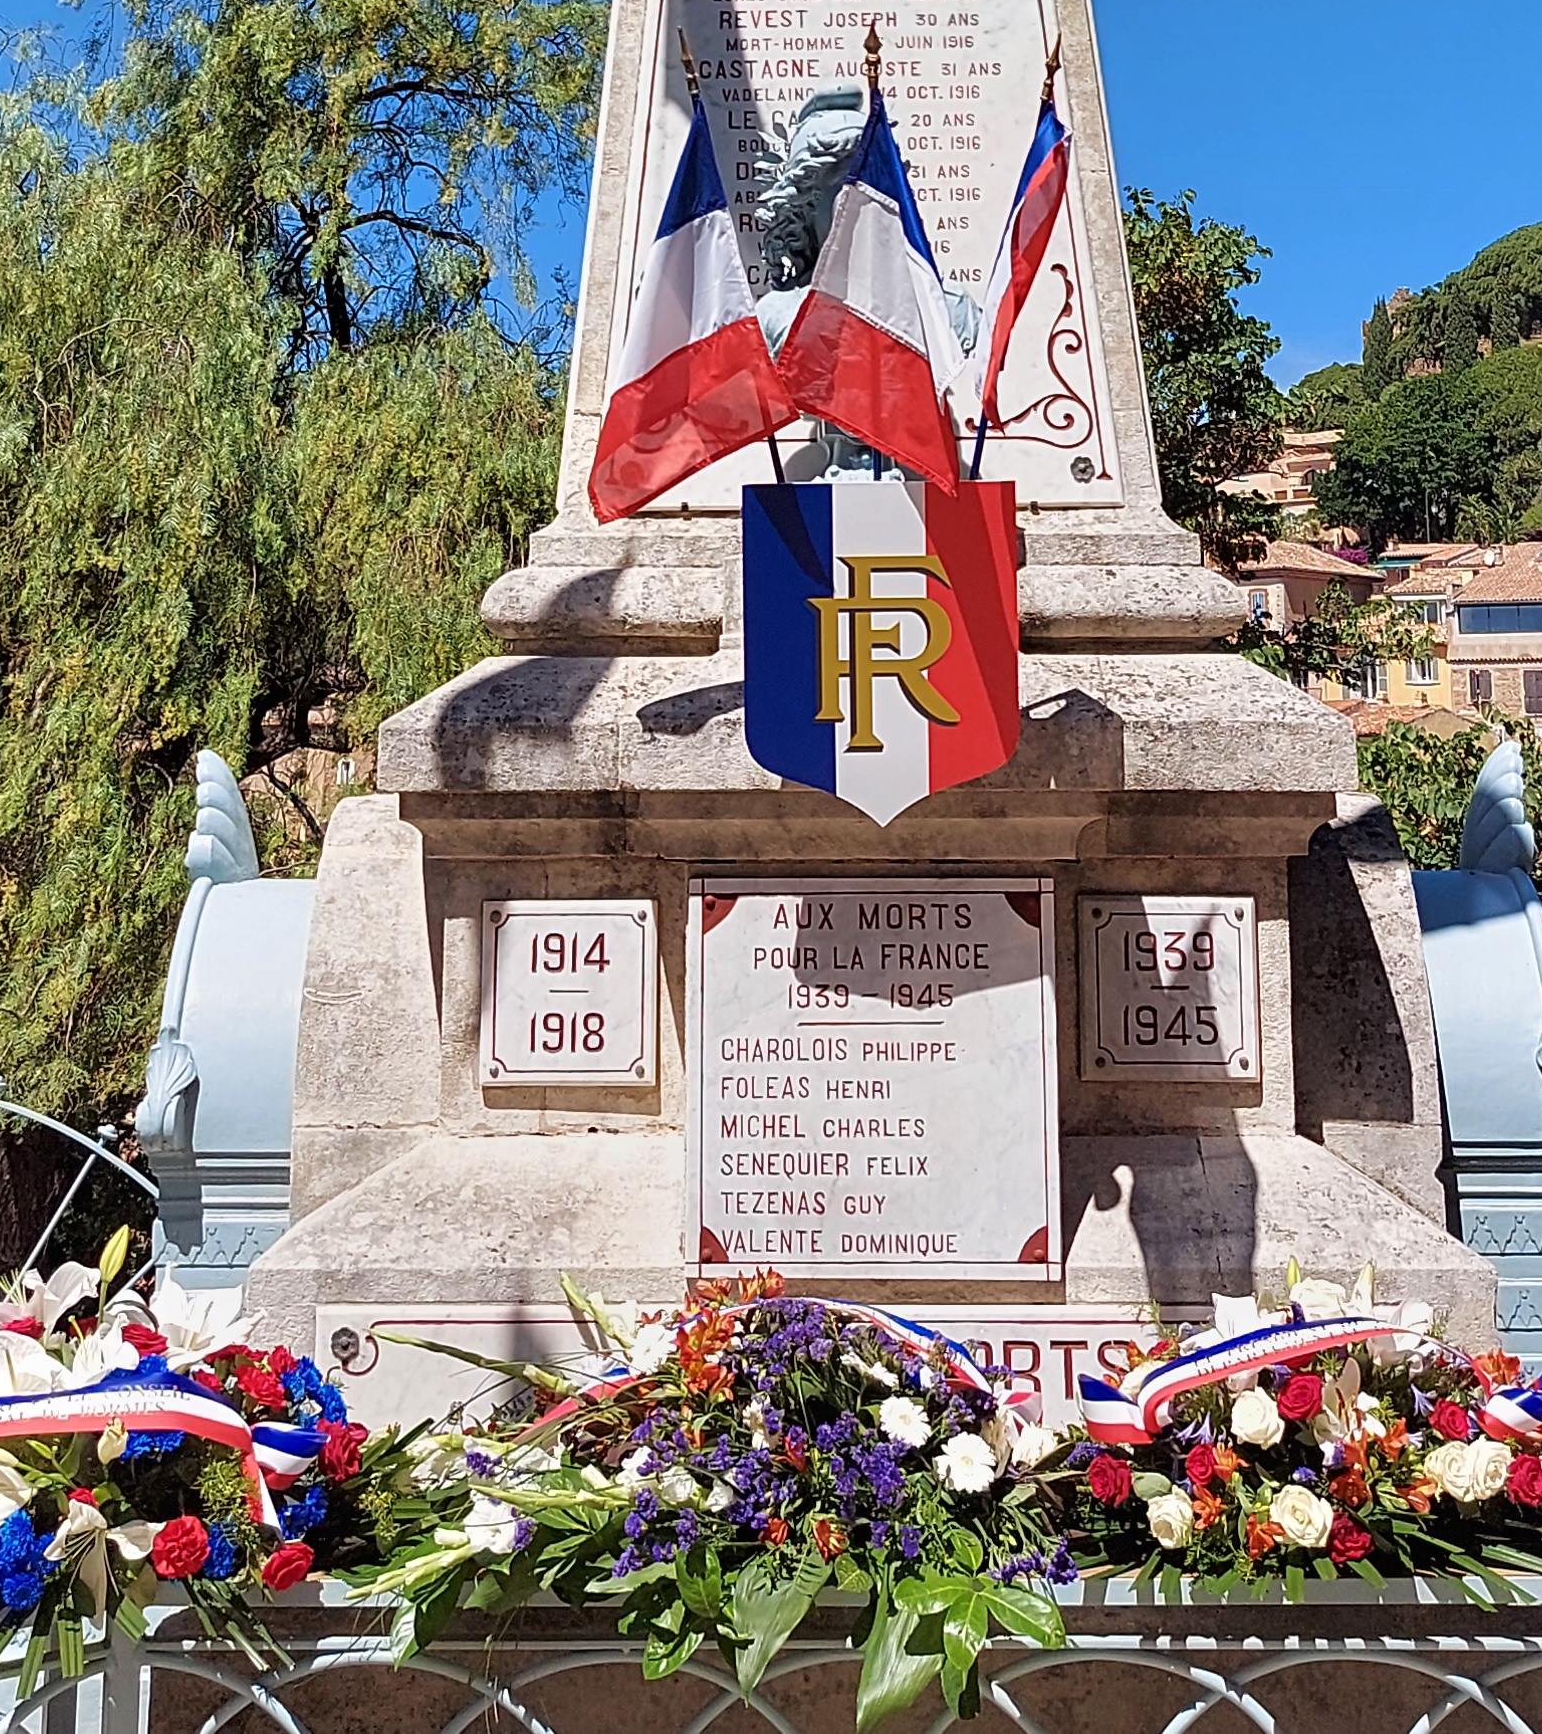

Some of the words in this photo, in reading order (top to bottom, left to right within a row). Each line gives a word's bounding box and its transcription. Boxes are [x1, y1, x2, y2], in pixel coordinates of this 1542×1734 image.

[720, 9, 807, 29] REVEST
[823, 12, 897, 28] JOSEPH
[916, 14, 937, 26] 30
[947, 13, 979, 26] ANS
[895, 36, 932, 49] JUIN
[943, 36, 974, 49] 1916
[700, 60, 820, 79] CASTAGNE
[968, 63, 1001, 76] ANS
[950, 85, 980, 99] 1916
[728, 112, 757, 130] LE
[911, 114, 931, 127] 20
[943, 114, 974, 126] ANS
[951, 136, 980, 150] 1916
[938, 165, 969, 178] ANS
[914, 188, 942, 202] CT.
[950, 188, 980, 201] 1916
[937, 217, 969, 230] ANS
[949, 269, 981, 282] ANS
[773, 903, 834, 929] AUX
[859, 903, 972, 929] MORTS
[531, 932, 610, 973] 1914
[755, 946, 818, 969] POUR
[834, 946, 864, 969] LA
[881, 944, 989, 969] FRANCE
[1124, 931, 1215, 971] 1939
[788, 984, 849, 1009] 1939
[891, 984, 954, 1008] 1945
[531, 1012, 605, 1053] 1918
[1124, 1005, 1218, 1045] 1945
[722, 1038, 847, 1063] CHAROLOIS
[863, 1042, 956, 1062] PHILIPPE
[722, 1076, 809, 1099] FOLEAS
[827, 1080, 890, 1100] HENRI
[721, 1114, 805, 1139] MICHEL
[823, 1118, 924, 1138] CHARLES
[721, 1152, 848, 1183] SENEQUIER
[867, 1156, 927, 1176] FELIX
[721, 1191, 825, 1215] TEZENAS
[844, 1194, 885, 1215] GUY
[722, 1230, 823, 1254] VALENTE
[842, 1234, 957, 1257] DOMINIQUE
